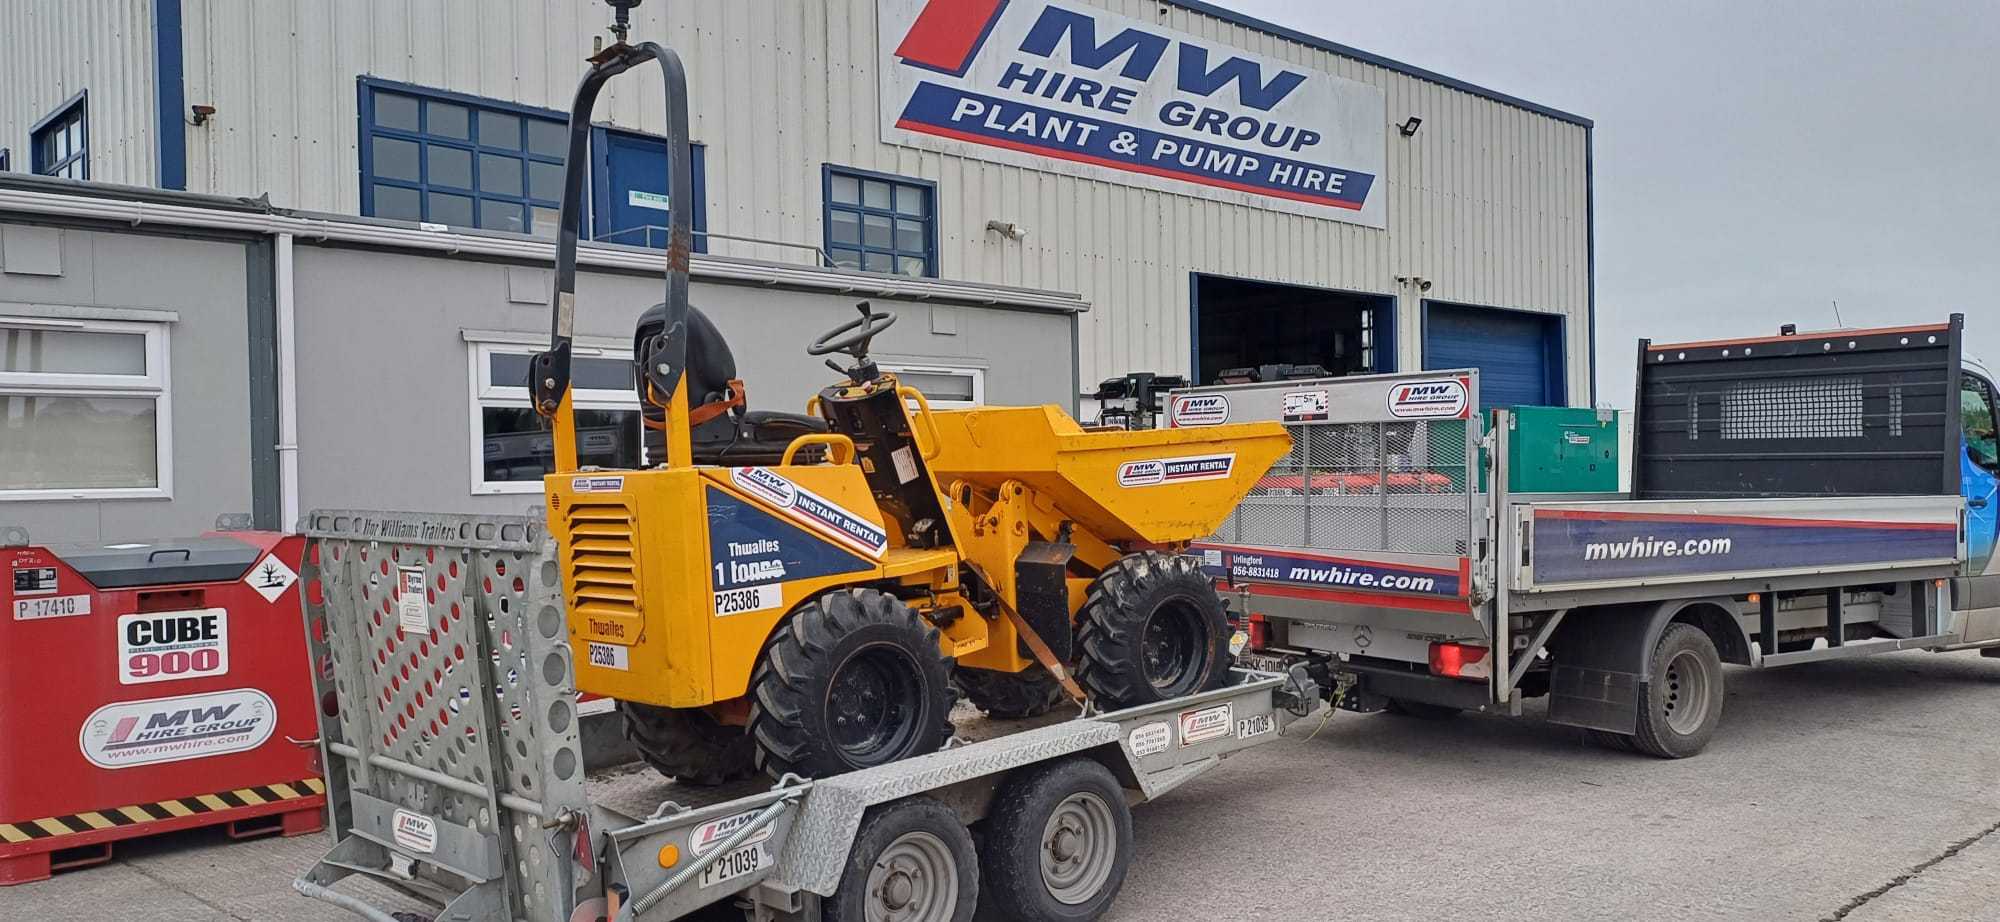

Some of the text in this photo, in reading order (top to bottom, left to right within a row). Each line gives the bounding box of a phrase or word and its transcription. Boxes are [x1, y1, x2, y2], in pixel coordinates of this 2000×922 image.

[1018, 5, 1307, 111] MW
[998, 62, 1320, 152] HIRE GROUP
[951, 97, 1347, 194] PLANT & PUMP HIRE
[1412, 386, 1450, 395] MW
[1190, 399, 1217, 407] MW
[754, 469, 785, 487] MW
[1133, 463, 1156, 471] MW
[1167, 460, 1227, 474] INSTANT RENTAL
[363, 519, 455, 541] Ifor Williams Trailers
[799, 495, 880, 546] INSTANT RENTAL
[728, 539, 779, 557] Thwaites
[1584, 536, 1732, 560] mwhire.com
[1233, 554, 1262, 566] Urlingford
[715, 562, 725, 585] 1
[1232, 567, 1280, 578] 056-8831418
[1289, 566, 1434, 591] mwhire.com
[19, 597, 75, 618] P 17410
[715, 588, 760, 614] P25386
[127, 615, 218, 646] CUBE
[589, 618, 624, 638] Thwaites
[129, 648, 219, 677] 900
[590, 644, 615, 666] P25386
[145, 703, 242, 730] MW
[1198, 713, 1220, 724] MW
[1240, 715, 1269, 737] P 21039
[136, 717, 262, 741] HIRE GROUP
[107, 734, 250, 759] www.mwhire.com
[406, 817, 428, 830] MW
[718, 811, 760, 831] MW
[718, 847, 759, 880] 21039
